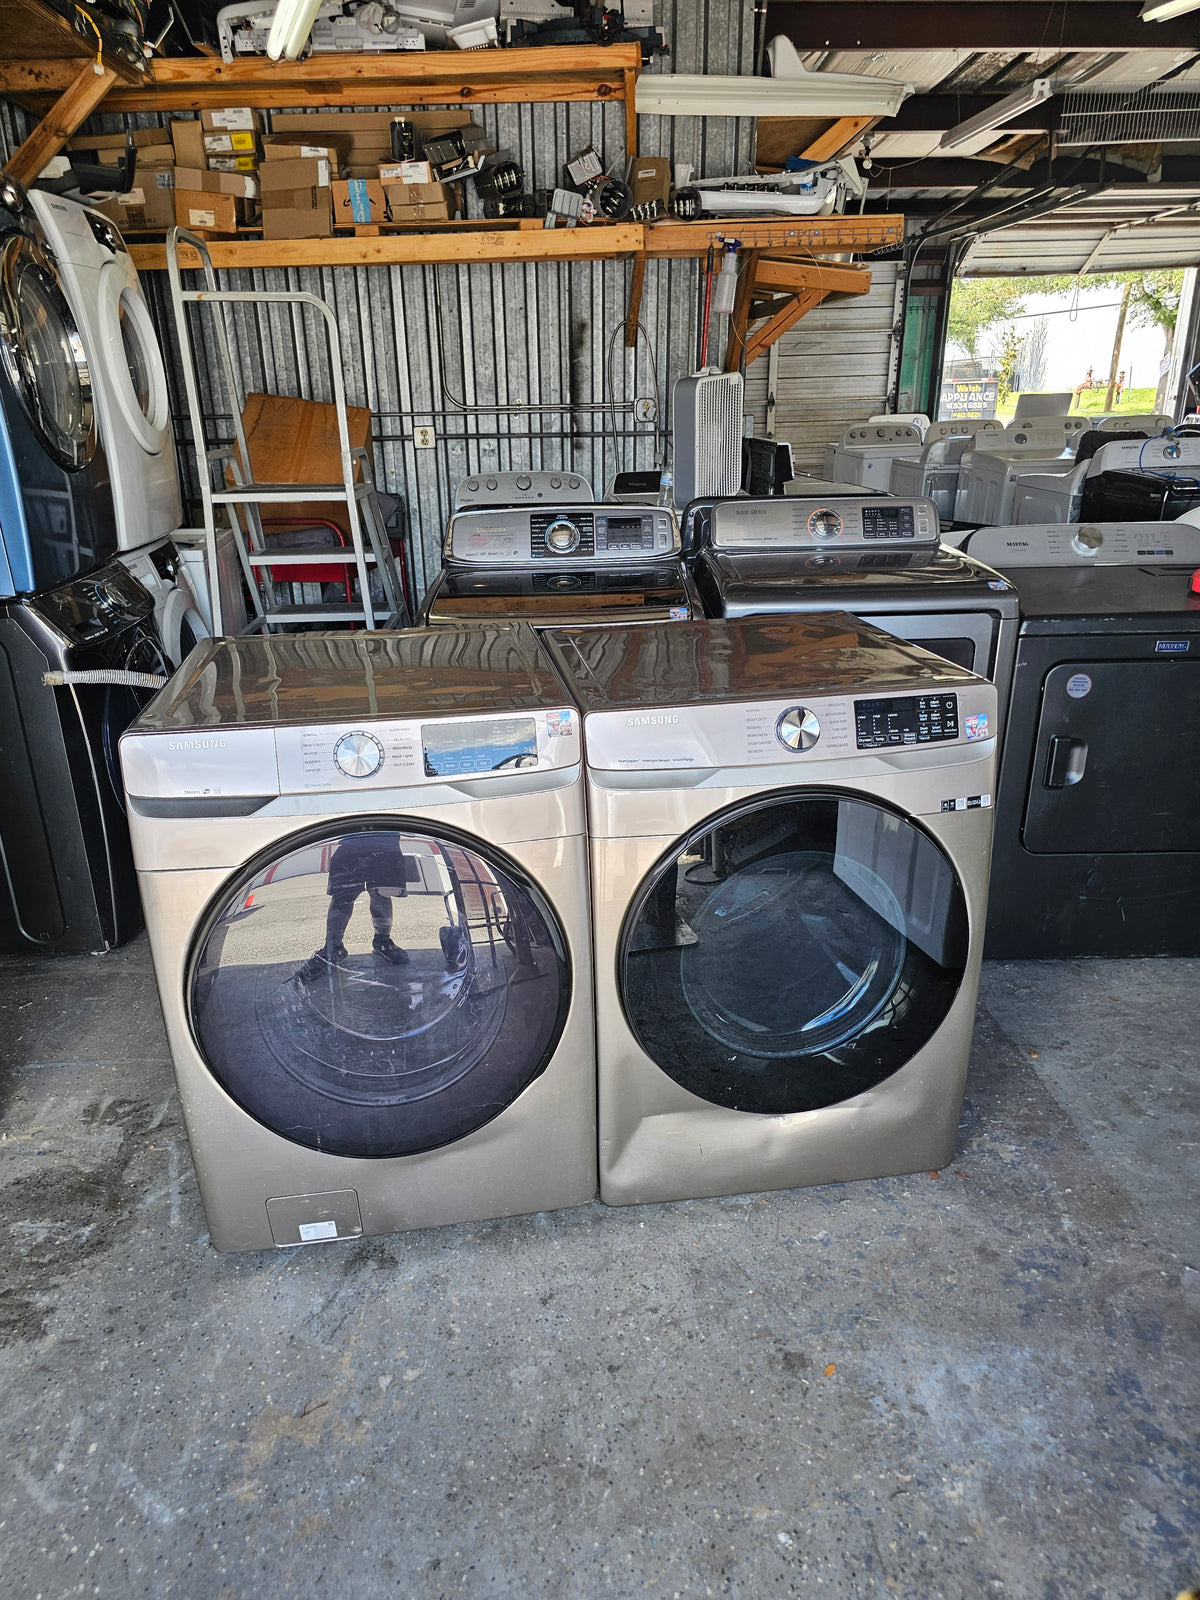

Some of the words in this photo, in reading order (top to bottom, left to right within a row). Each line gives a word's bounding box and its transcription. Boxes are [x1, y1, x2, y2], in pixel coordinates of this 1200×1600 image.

[940, 392, 995, 402] APPLIANCE
[627, 714, 679, 727] SAMSUNG
[168, 739, 227, 751] SAMSUNG
